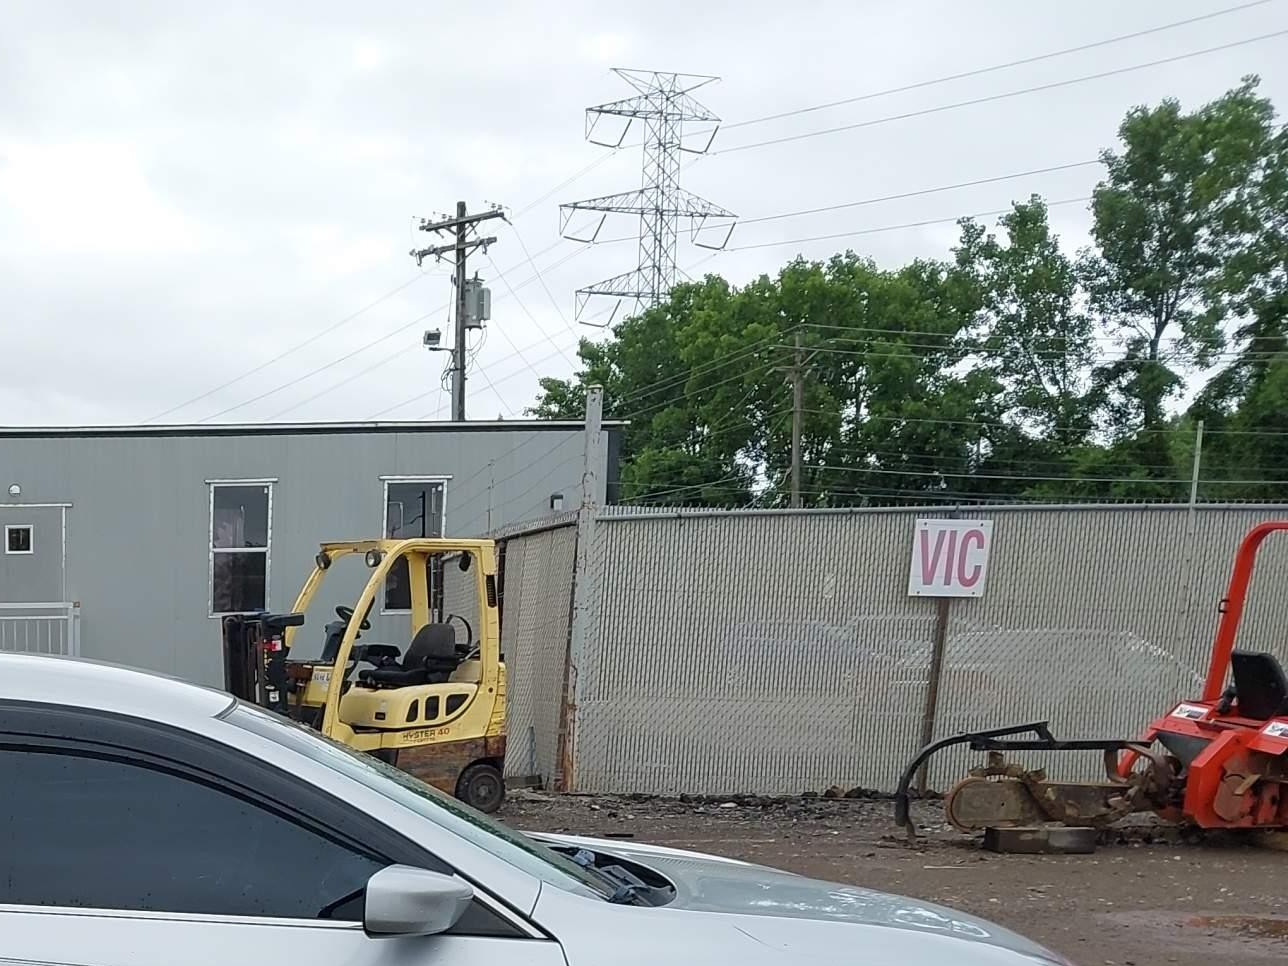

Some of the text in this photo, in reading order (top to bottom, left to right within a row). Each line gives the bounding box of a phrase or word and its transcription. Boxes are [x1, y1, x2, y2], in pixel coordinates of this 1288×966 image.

[920, 529, 984, 587] VIC
[402, 729, 436, 740] HYSTER
[438, 727, 450, 735] 40
